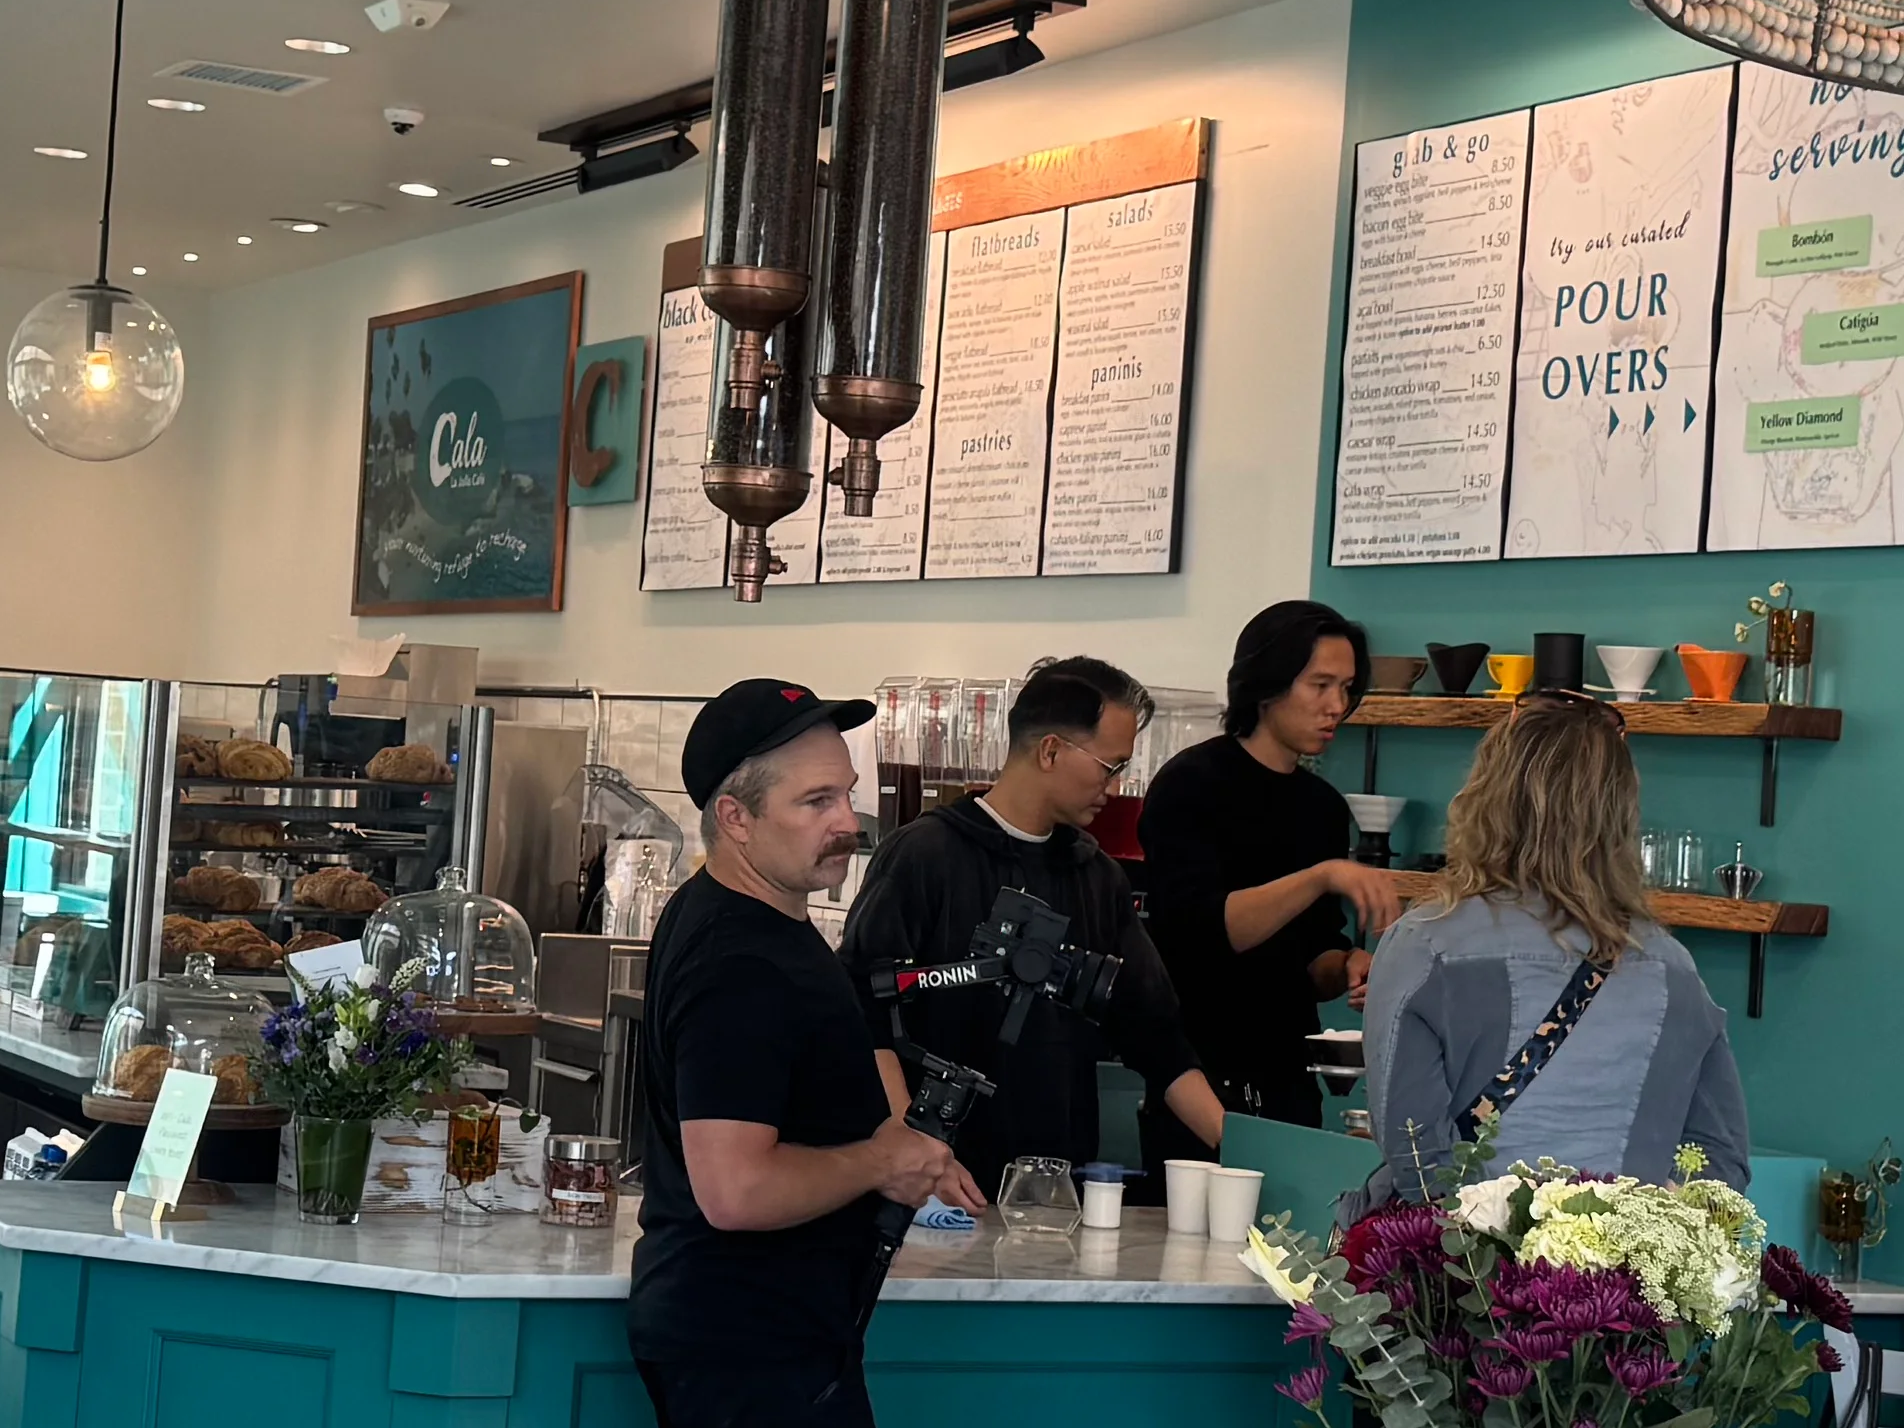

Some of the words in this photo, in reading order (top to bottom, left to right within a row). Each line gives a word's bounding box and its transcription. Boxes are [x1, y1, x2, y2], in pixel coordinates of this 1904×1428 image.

[1443, 134, 1458, 160] &
[1465, 133, 1490, 164] go
[1394, 179, 1409, 196] egg
[1491, 155, 1515, 173] 8.50
[1107, 198, 1154, 228] salads
[1362, 216, 1389, 234] bacon
[1391, 216, 1406, 233] egg
[1407, 208, 1424, 224] bite
[1488, 193, 1512, 211] 8.50
[972, 225, 1041, 258] flatbreads
[1360, 250, 1395, 269] breakfast
[1480, 230, 1510, 249] 14.50
[1550, 236, 1574, 264] try
[1585, 232, 1612, 253] our
[1621, 209, 1692, 248] curated
[1791, 230, 1834, 248] Bombón
[1160, 264, 1183, 279] 15.50
[1476, 282, 1505, 300] 12.50
[1554, 272, 1668, 328] POUR
[663, 294, 698, 329] black
[1157, 306, 1180, 322] 15.50
[1478, 334, 1502, 350] 6.50
[1091, 356, 1143, 390] paninis
[1350, 384, 1381, 400] chicken
[1382, 379, 1416, 397] avocado
[1416, 380, 1440, 397] wrap
[1470, 371, 1500, 388] 14.50
[1542, 345, 1669, 400] OVERS
[1760, 413, 1793, 430] Yellow
[1796, 407, 1844, 427] Diamond
[429, 411, 488, 488] Cala
[960, 429, 1013, 460] pastries
[1347, 436, 1373, 450] caesar
[1375, 434, 1395, 450] wrap
[1466, 422, 1496, 438] 14.50
[1363, 484, 1385, 501] wrap
[1462, 473, 1491, 489] 14.50
[405, 541, 442, 584] nurturing
[443, 553, 473, 580] refuge
[475, 539, 487, 558] to
[489, 528, 528, 562] recharge
[918, 965, 977, 989] RONIN
